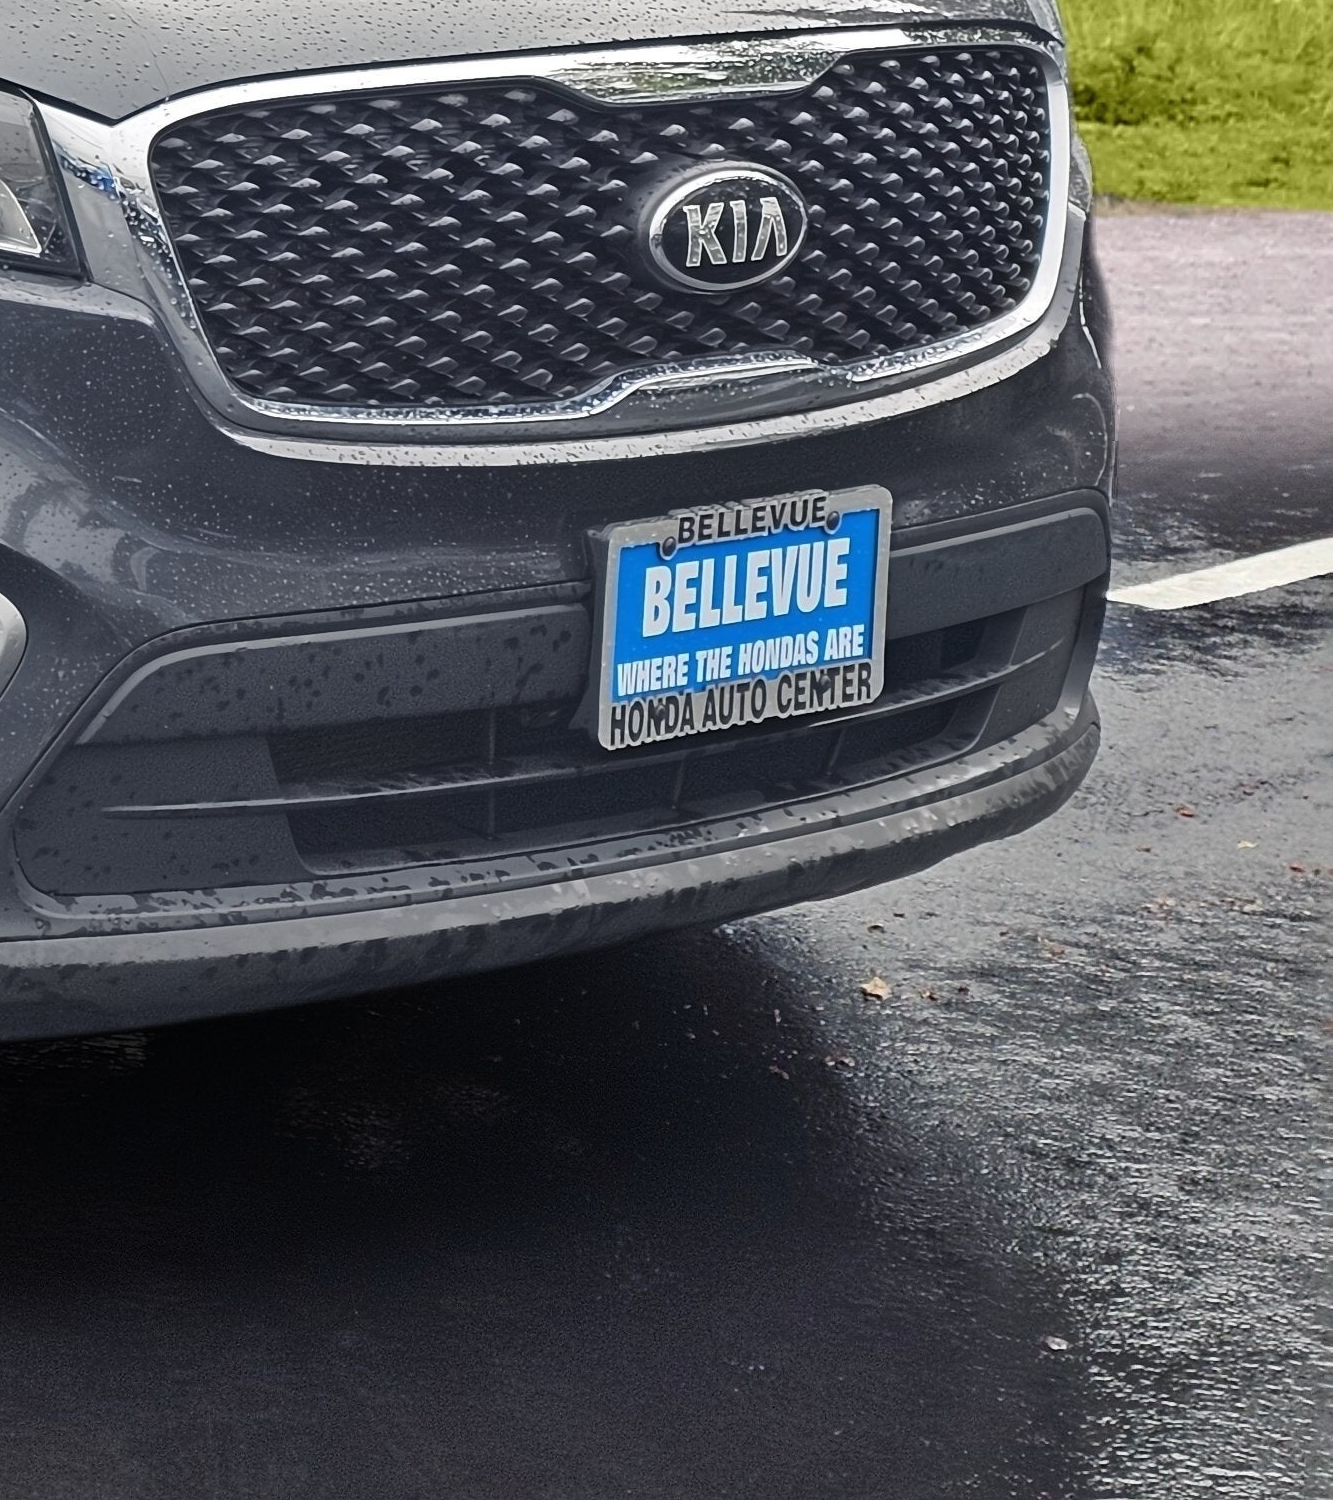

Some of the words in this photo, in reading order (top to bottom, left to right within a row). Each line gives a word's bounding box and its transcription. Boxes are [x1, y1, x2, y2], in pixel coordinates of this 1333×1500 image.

[683, 196, 788, 267] KIA
[677, 496, 828, 544] BELLEVUE
[641, 537, 851, 638] BELLEVUE
[617, 652, 690, 696] WHERE
[695, 645, 733, 683] THE
[737, 631, 819, 674] HONDAS
[823, 623, 865, 661] ARE
[610, 692, 696, 746] HONDA
[701, 679, 767, 728] AUTO
[776, 662, 873, 716] CENTER
